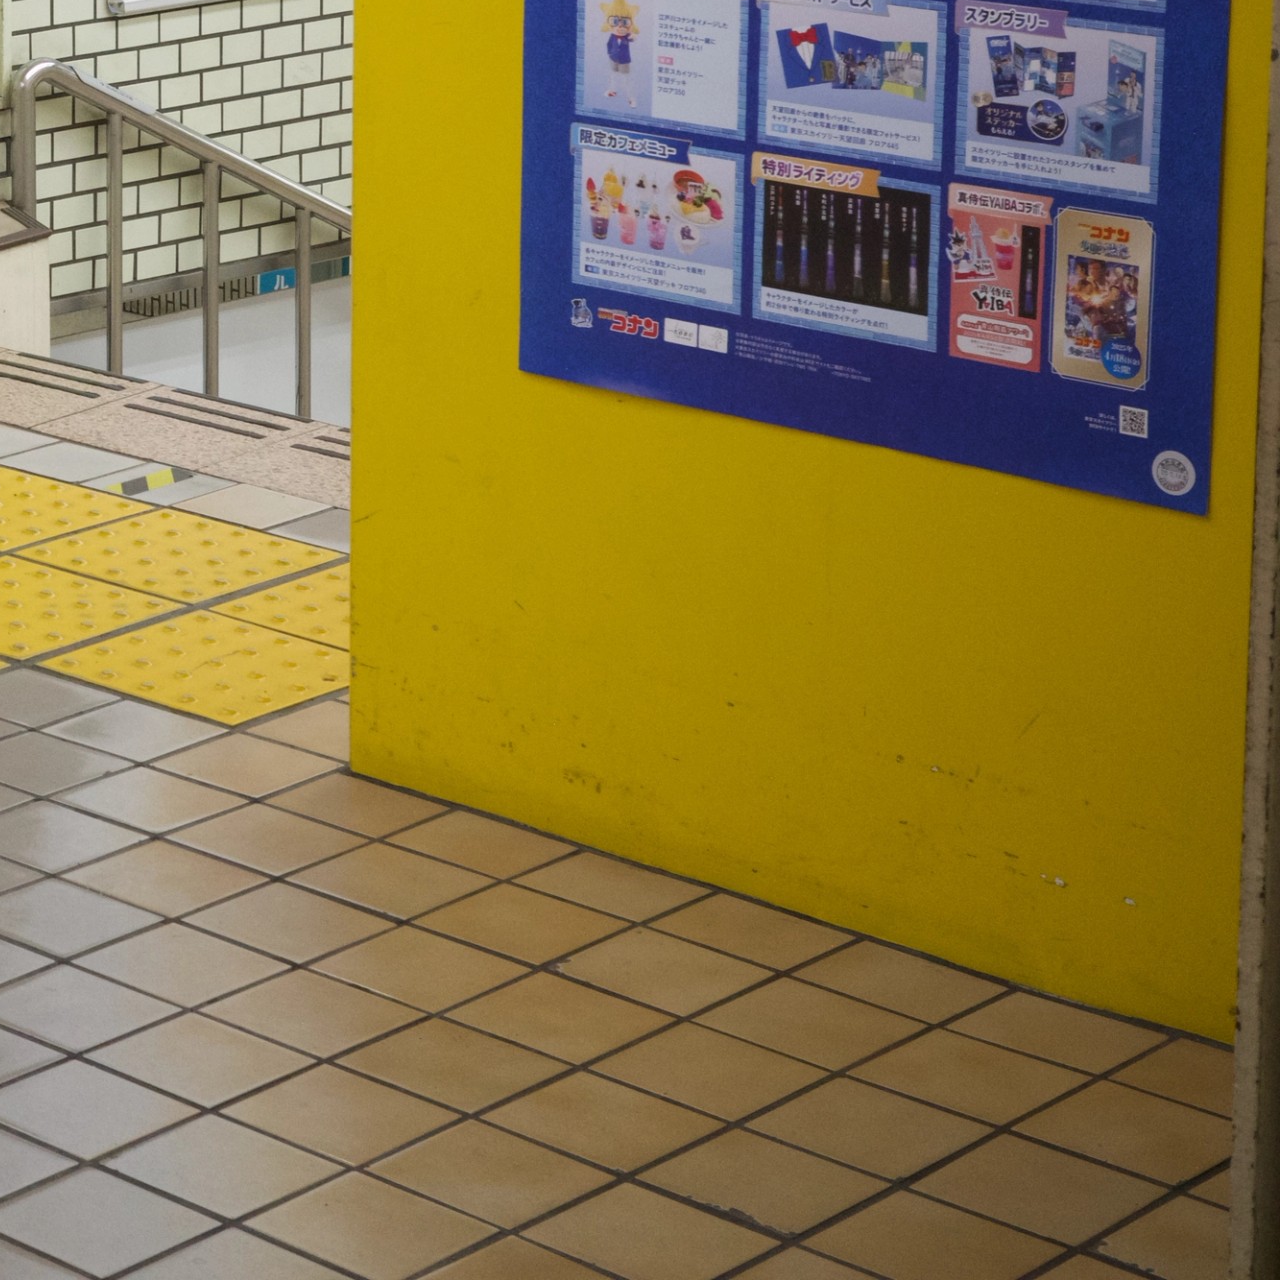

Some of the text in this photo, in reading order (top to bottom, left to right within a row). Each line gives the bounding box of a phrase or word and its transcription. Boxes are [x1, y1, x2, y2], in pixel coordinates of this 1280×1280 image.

[965, 7, 1049, 31] スタンプラリー
[579, 129, 676, 158] 限定カフェメニュー
[761, 158, 863, 189] 特別ライティング
